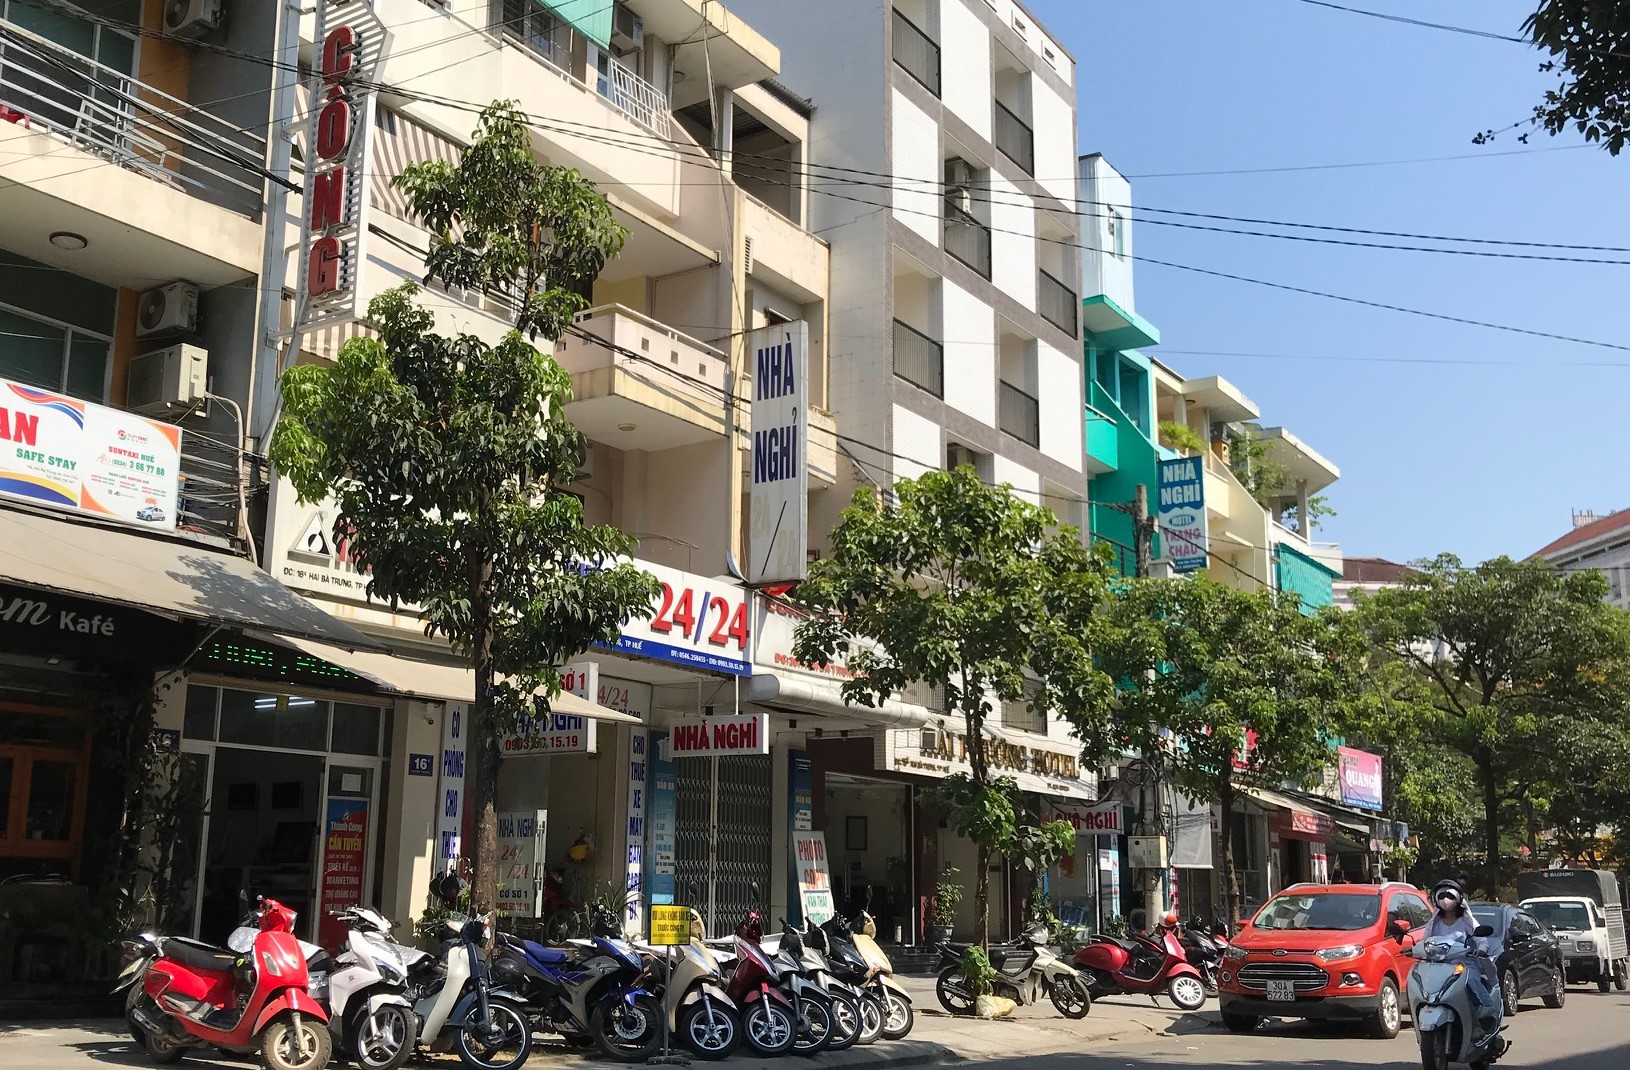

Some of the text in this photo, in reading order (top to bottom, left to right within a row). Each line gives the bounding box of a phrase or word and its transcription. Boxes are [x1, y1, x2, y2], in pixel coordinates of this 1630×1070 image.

[758, 332, 794, 400] NHÀ
[108, 446, 139, 459] SUNTAXI
[754, 407, 797, 483] NGHỈ
[16, 448, 76, 470] SAFE STAY
[146, 465, 154, 473] 77
[1163, 460, 1196, 483] NHÀ
[1161, 480, 1200, 505] NGHỈ
[309, 571, 320, 580] HAI
[322, 574, 329, 584] BÀ
[356, 582, 363, 590] TP
[60, 611, 115, 636] Kafé
[651, 581, 750, 649] 24/24
[632, 640, 642, 650] HUẾ
[579, 673, 585, 690] 1
[633, 735, 644, 754] CHO
[674, 716, 758, 751] NHÀ NGHỈ
[443, 745, 464, 778] PHÒNG
[631, 760, 645, 781] THUÊ
[1346, 770, 1373, 789] QUANG
[445, 789, 458, 817] CHO
[633, 790, 641, 808] XE
[499, 814, 514, 838] NHÀ
[629, 813, 643, 837] MÁY
[629, 841, 642, 864] BÁN
[797, 839, 824, 861] PHOTO
[326, 877, 359, 885] MARKETING
[804, 869, 825, 890] COPY
[524, 890, 527, 898] 1
[1273, 982, 1288, 990] 30A
